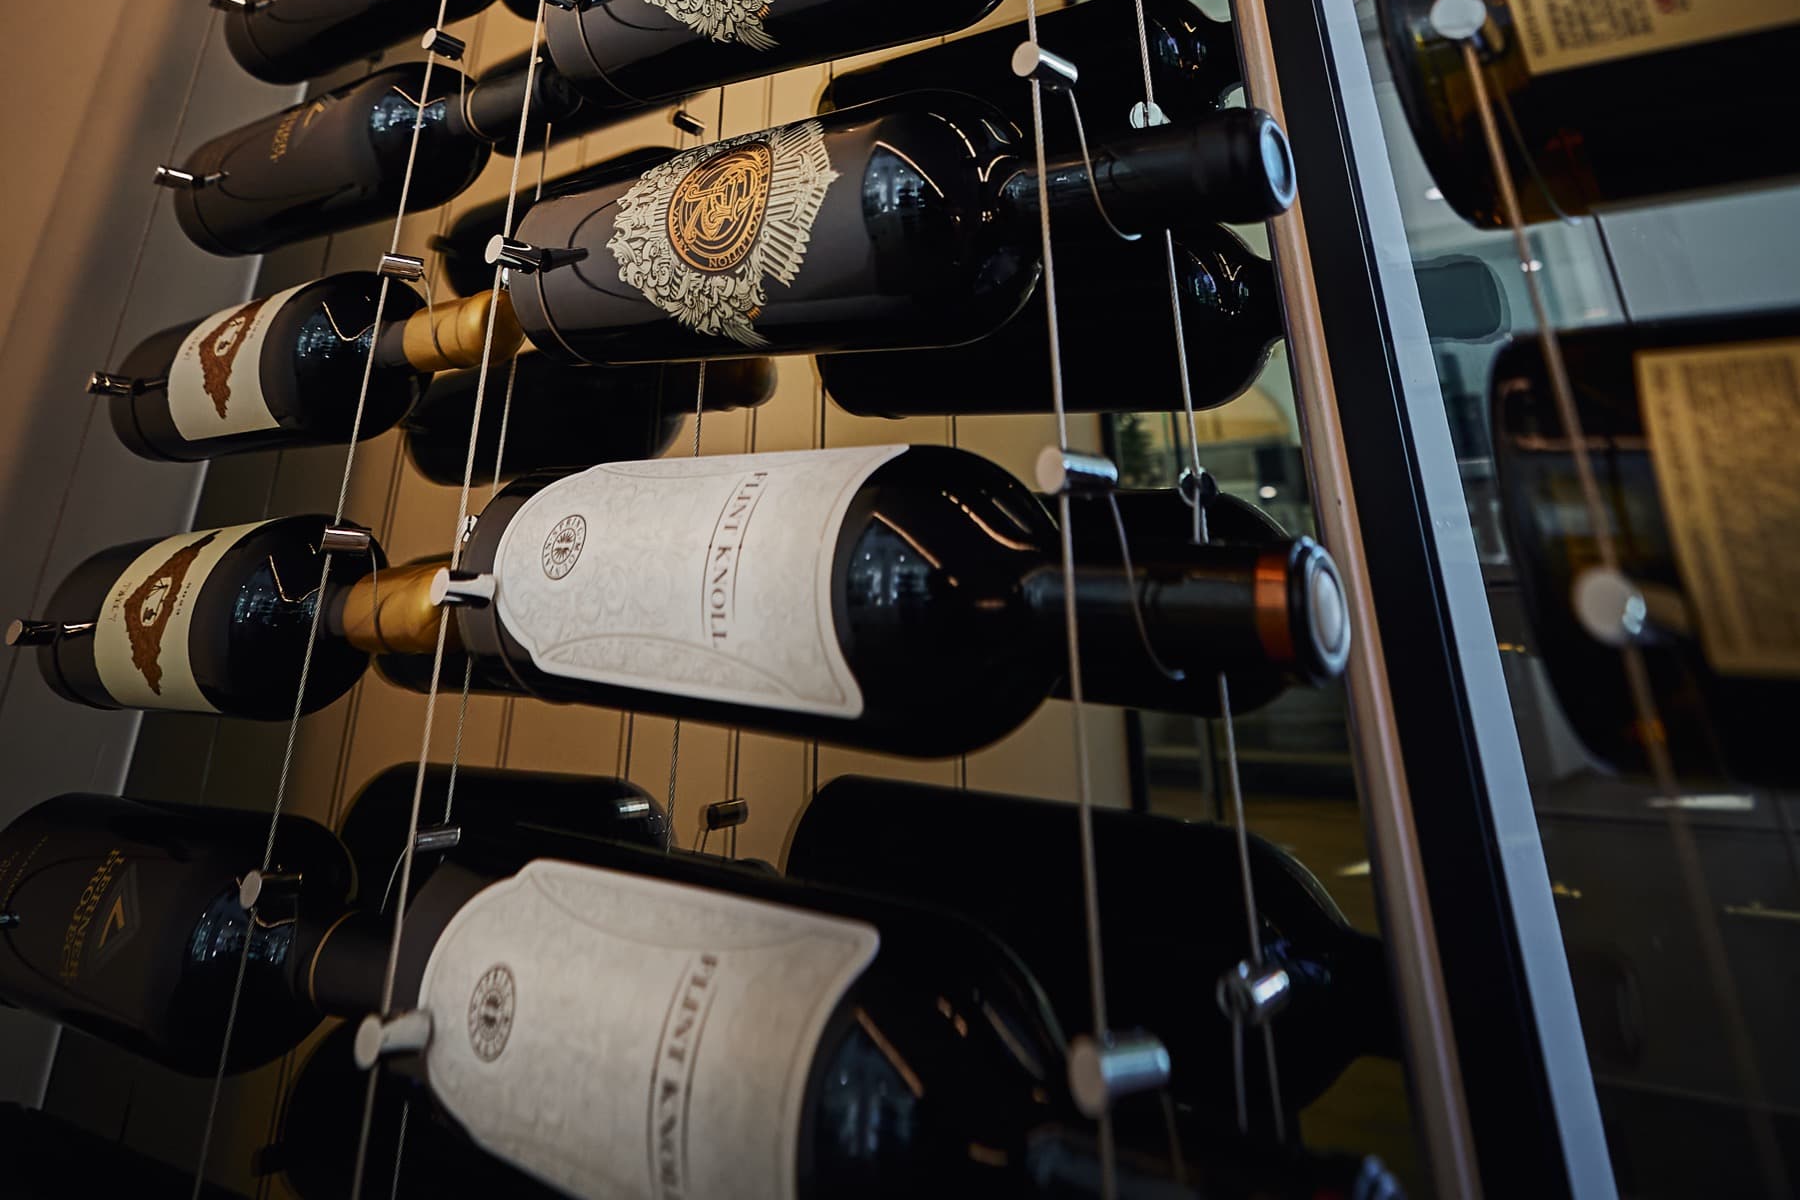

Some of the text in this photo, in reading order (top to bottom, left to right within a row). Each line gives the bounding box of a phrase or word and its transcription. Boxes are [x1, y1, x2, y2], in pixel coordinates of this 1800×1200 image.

[710, 471, 768, 649] FLINT KNOLL
[667, 954, 718, 1067] FLINT
